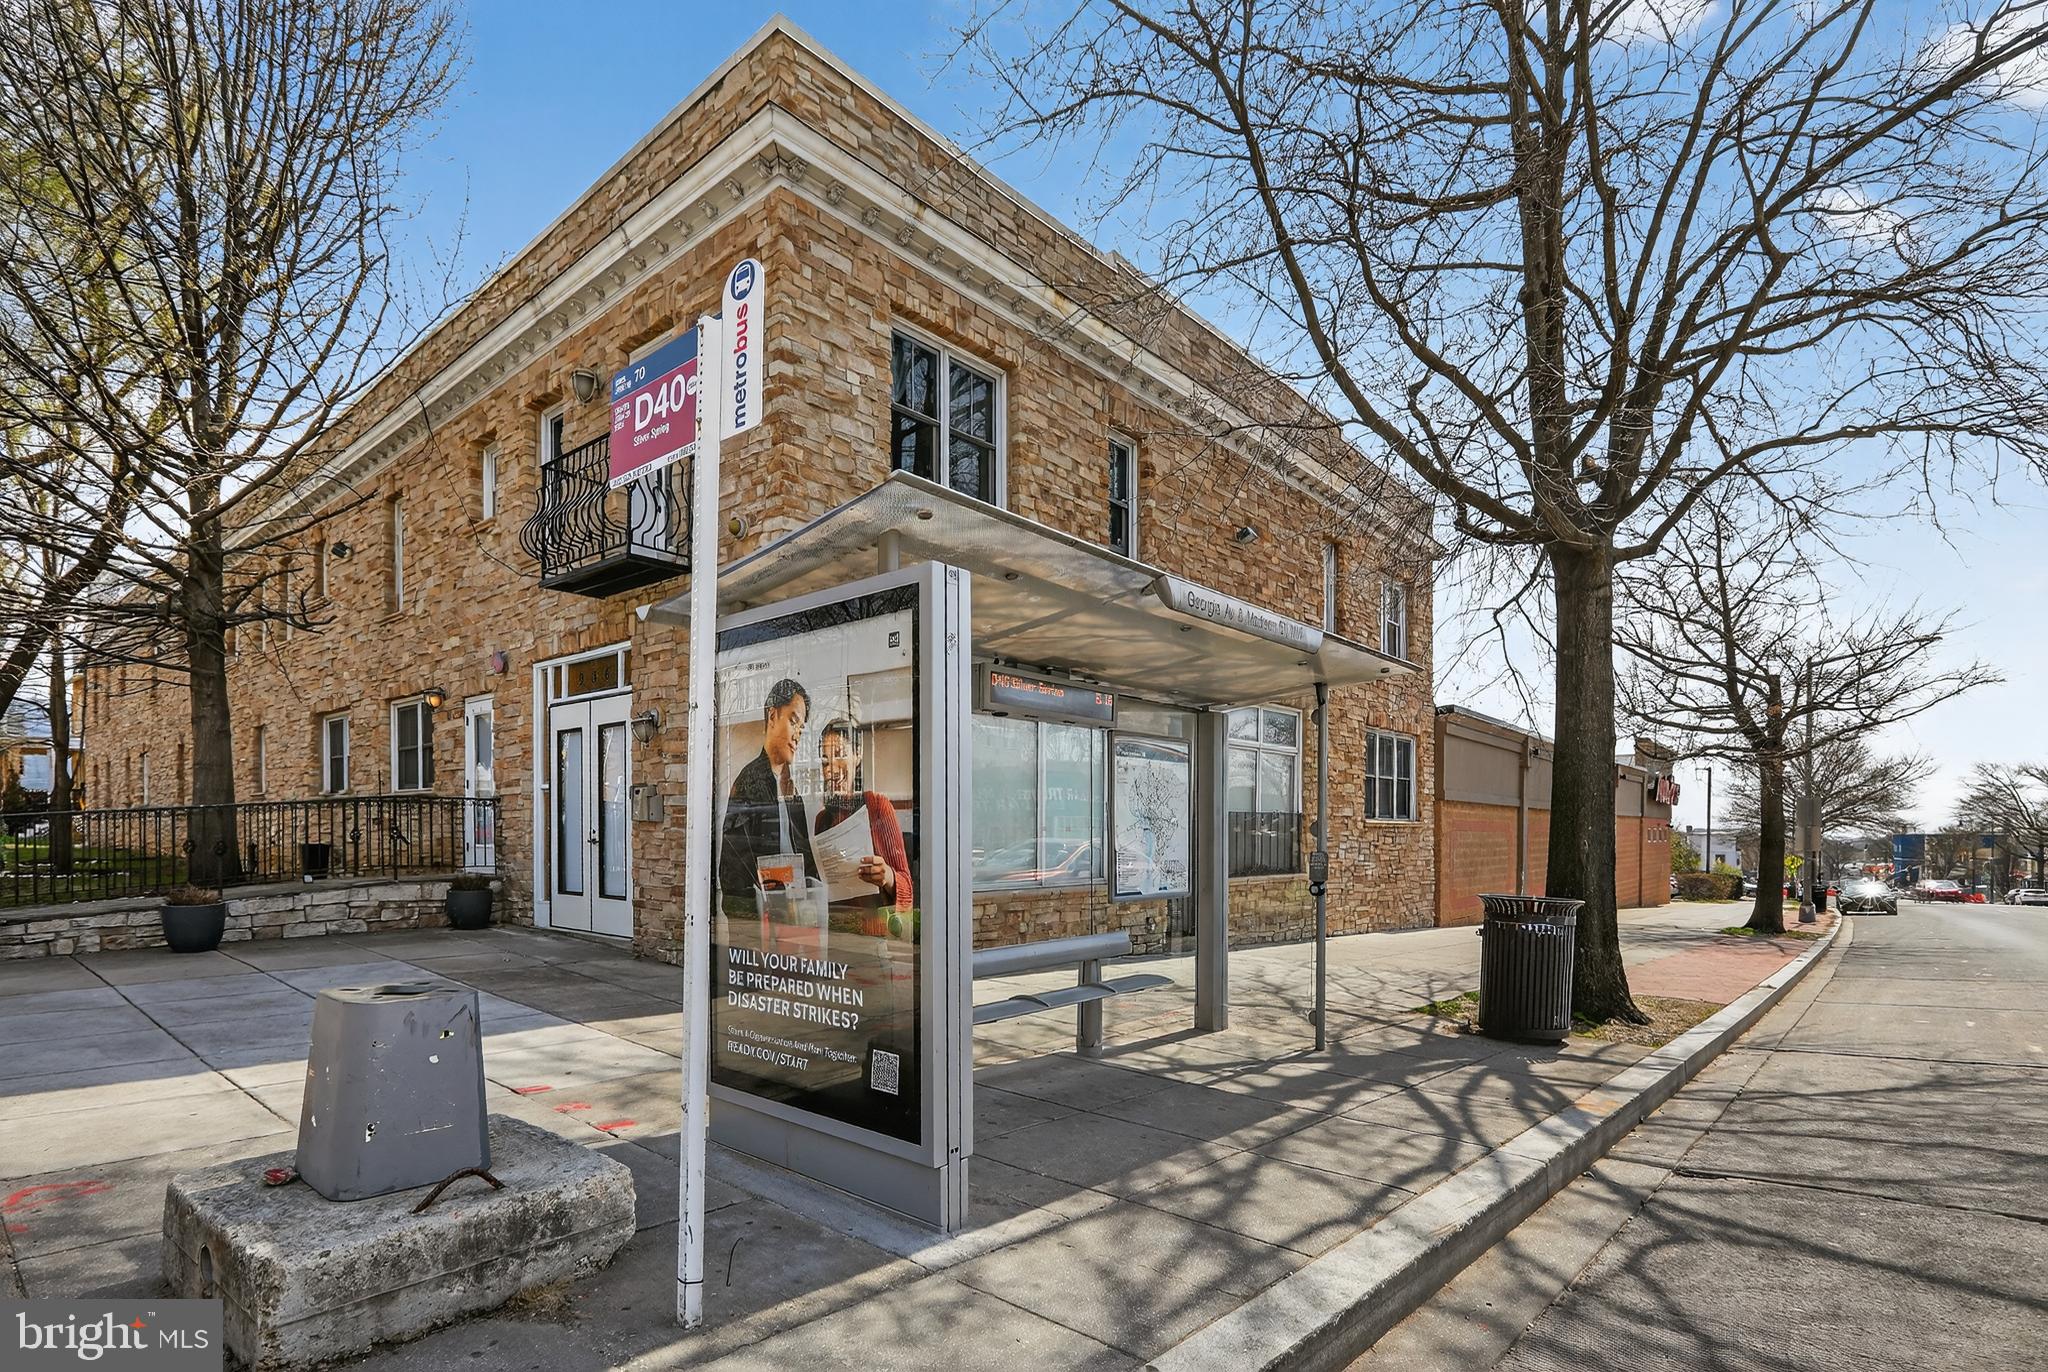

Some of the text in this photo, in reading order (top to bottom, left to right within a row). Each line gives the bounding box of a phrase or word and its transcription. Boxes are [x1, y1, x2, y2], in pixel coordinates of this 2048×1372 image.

[634, 366, 646, 383] 70
[733, 302, 749, 429] metrobus
[634, 373, 686, 432] D40
[650, 422, 670, 439] Spring
[1187, 590, 1221, 618] Georgia
[728, 947, 848, 980] WILL YOUR FAMILY
[728, 969, 864, 1007] BE PREPARED WHEN
[728, 990, 859, 1030] DISASTER STRIKES?
